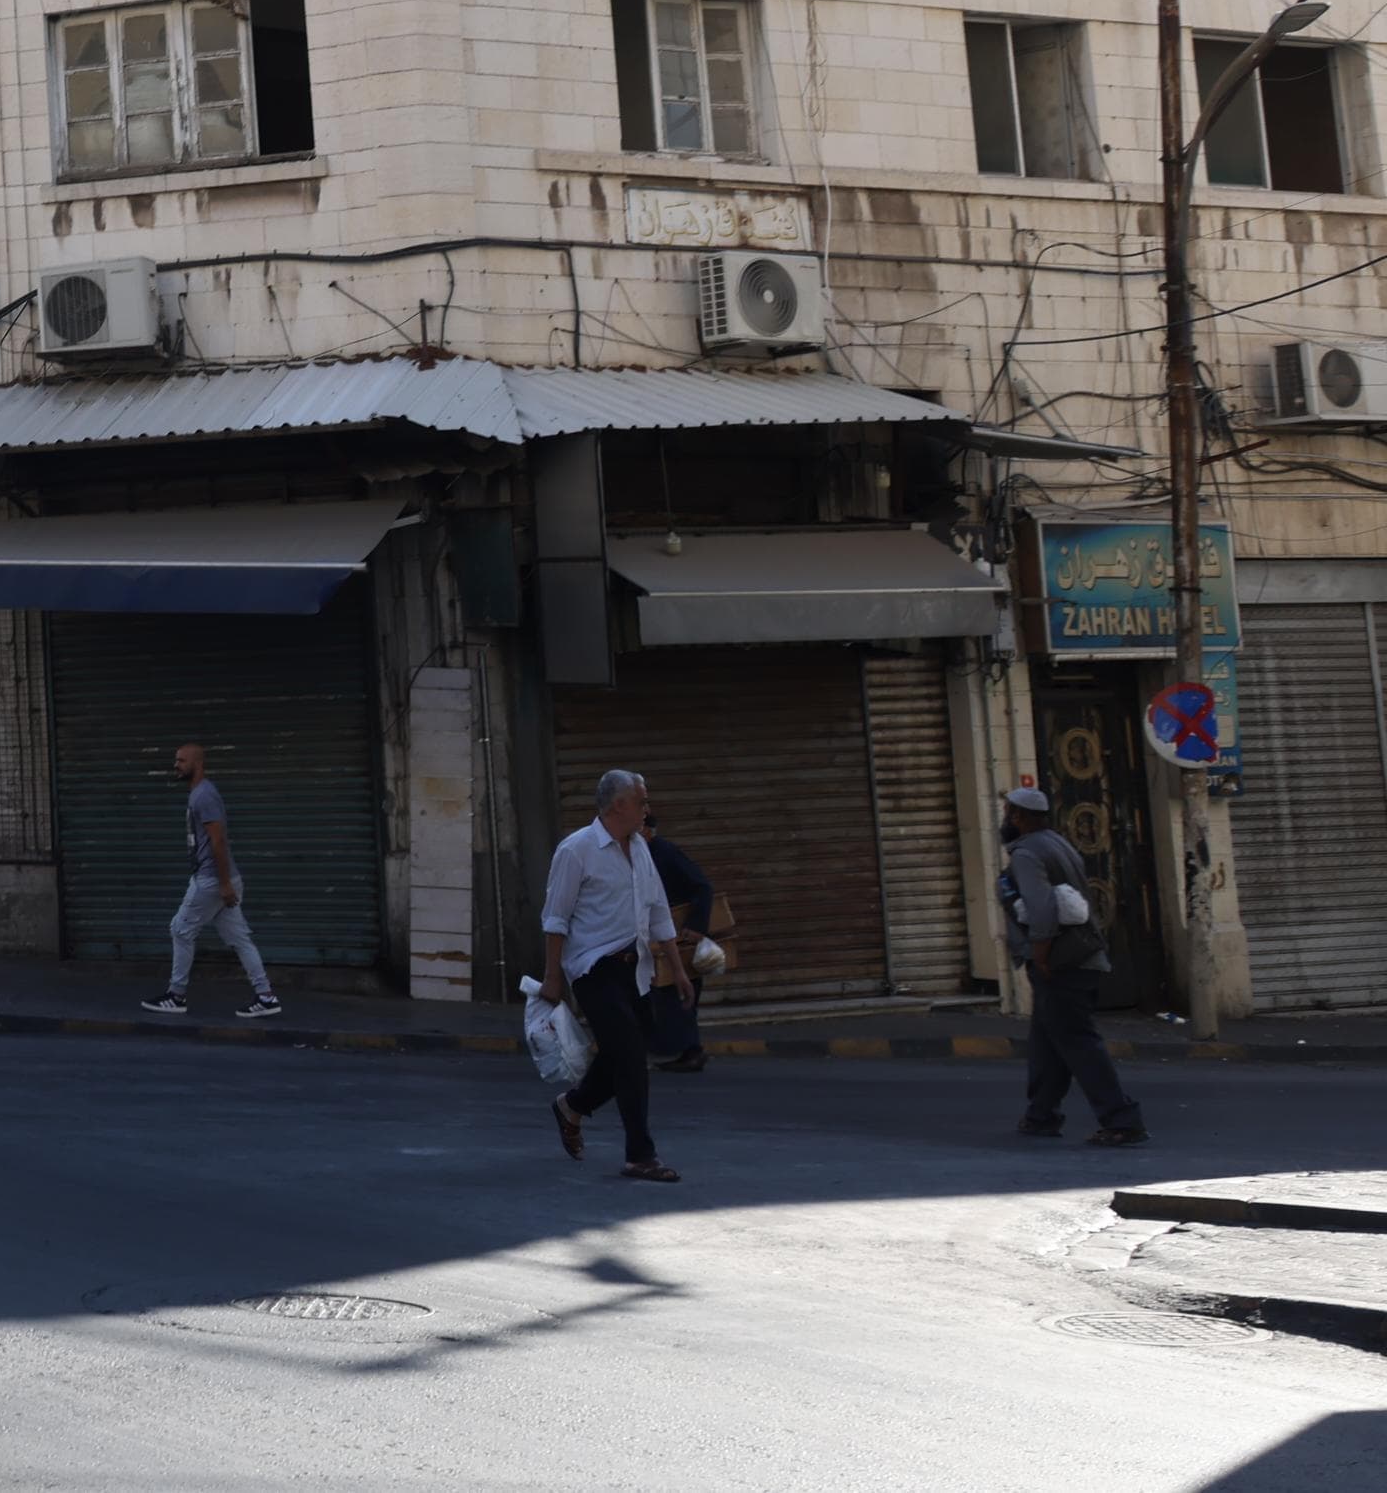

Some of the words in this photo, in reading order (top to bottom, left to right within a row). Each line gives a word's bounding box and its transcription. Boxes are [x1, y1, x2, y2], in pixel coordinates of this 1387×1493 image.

[638, 193, 713, 247] زهران
[1057, 539, 1142, 590] زهران
[1147, 537, 1222, 588] فنق
[1063, 607, 1151, 636] ZAHRAN
[1158, 606, 1227, 636] HEL
